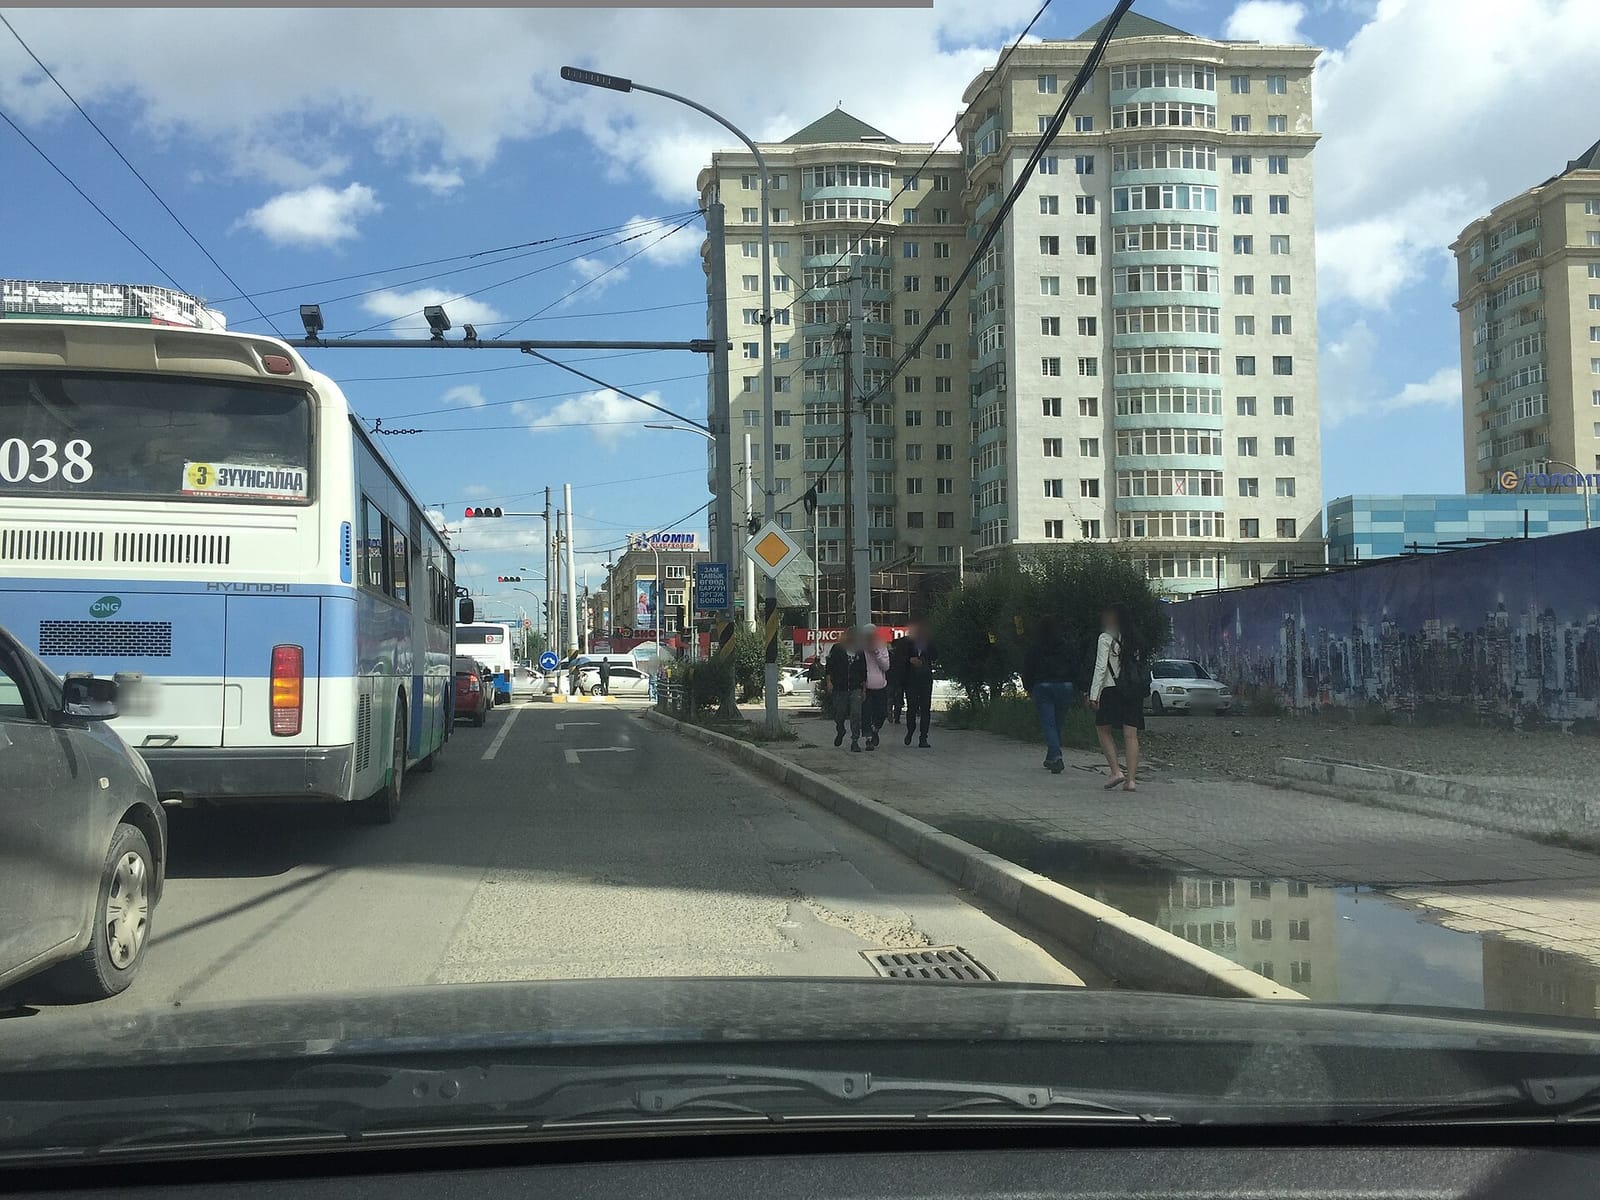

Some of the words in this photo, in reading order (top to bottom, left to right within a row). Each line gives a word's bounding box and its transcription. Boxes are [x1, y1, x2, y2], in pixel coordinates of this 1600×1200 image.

[0, 438, 94, 483] 038
[197, 466, 208, 485] 3
[218, 468, 304, 491] ЗҮҮНСАЛАА
[651, 533, 695, 543] NOMIN
[206, 582, 290, 593] HYUNDAI
[92, 602, 119, 613] CNG
